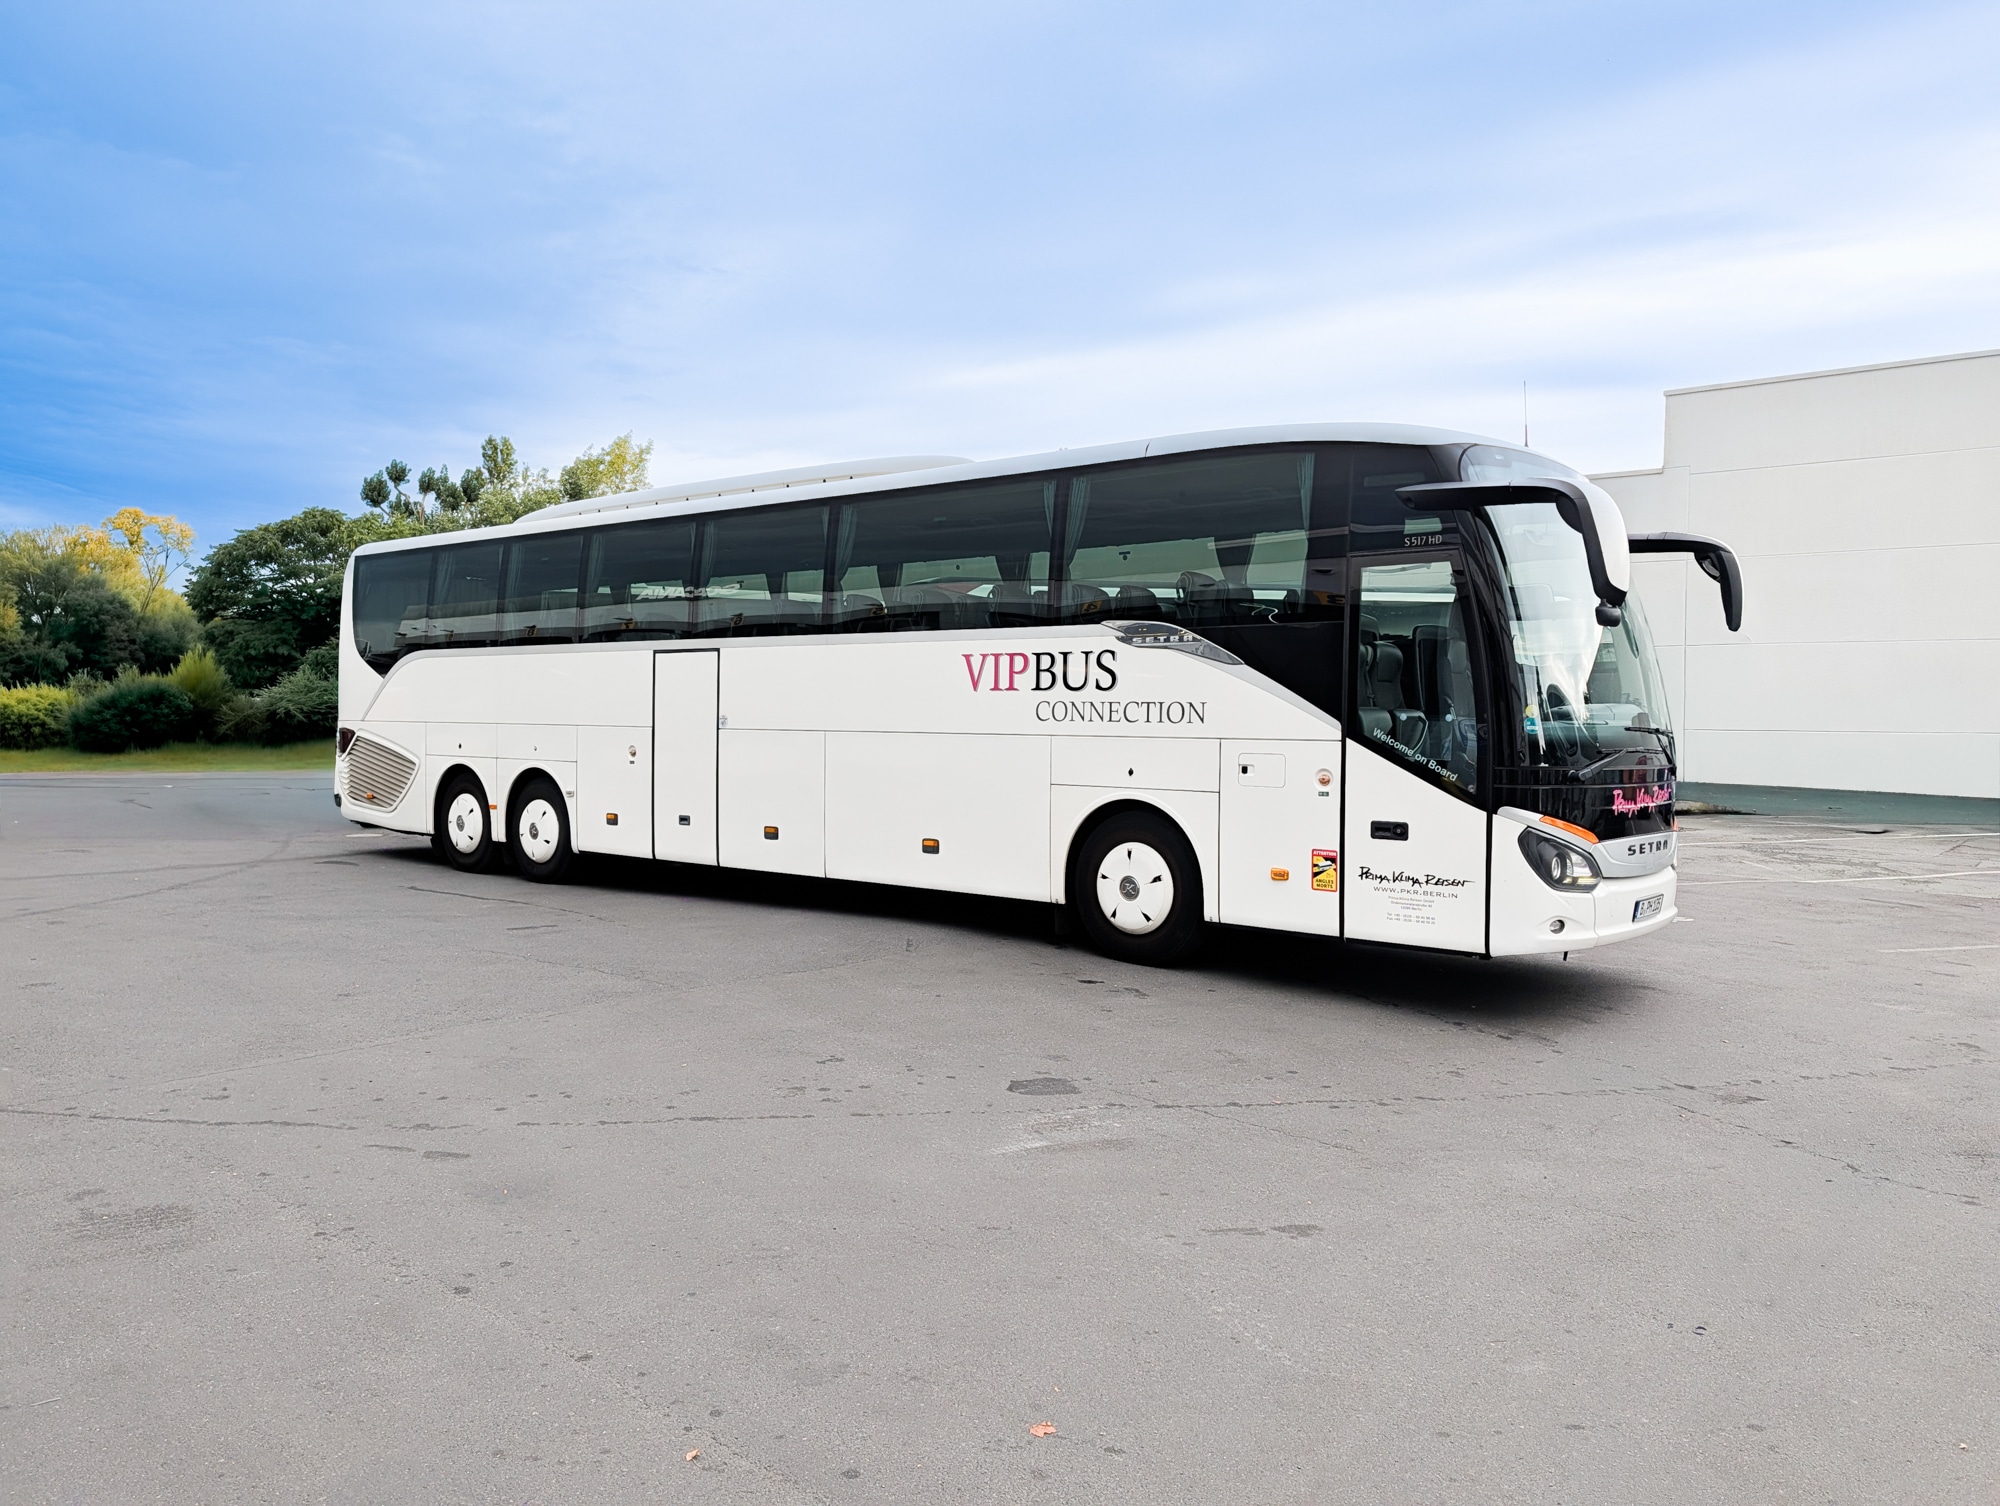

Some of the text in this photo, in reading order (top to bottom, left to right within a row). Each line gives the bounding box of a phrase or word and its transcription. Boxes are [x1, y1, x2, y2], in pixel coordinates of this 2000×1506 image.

[1404, 534, 1443, 547] S 517 HD
[1132, 635, 1193, 644] SETRA
[961, 649, 1118, 692] VIPBUS
[1035, 700, 1207, 724] CONNECTION
[1373, 727, 1459, 782] Welcome on Board
[1627, 840, 1668, 857] SETRA
[1373, 886, 1458, 899] WWW.PKR.BERLIN
